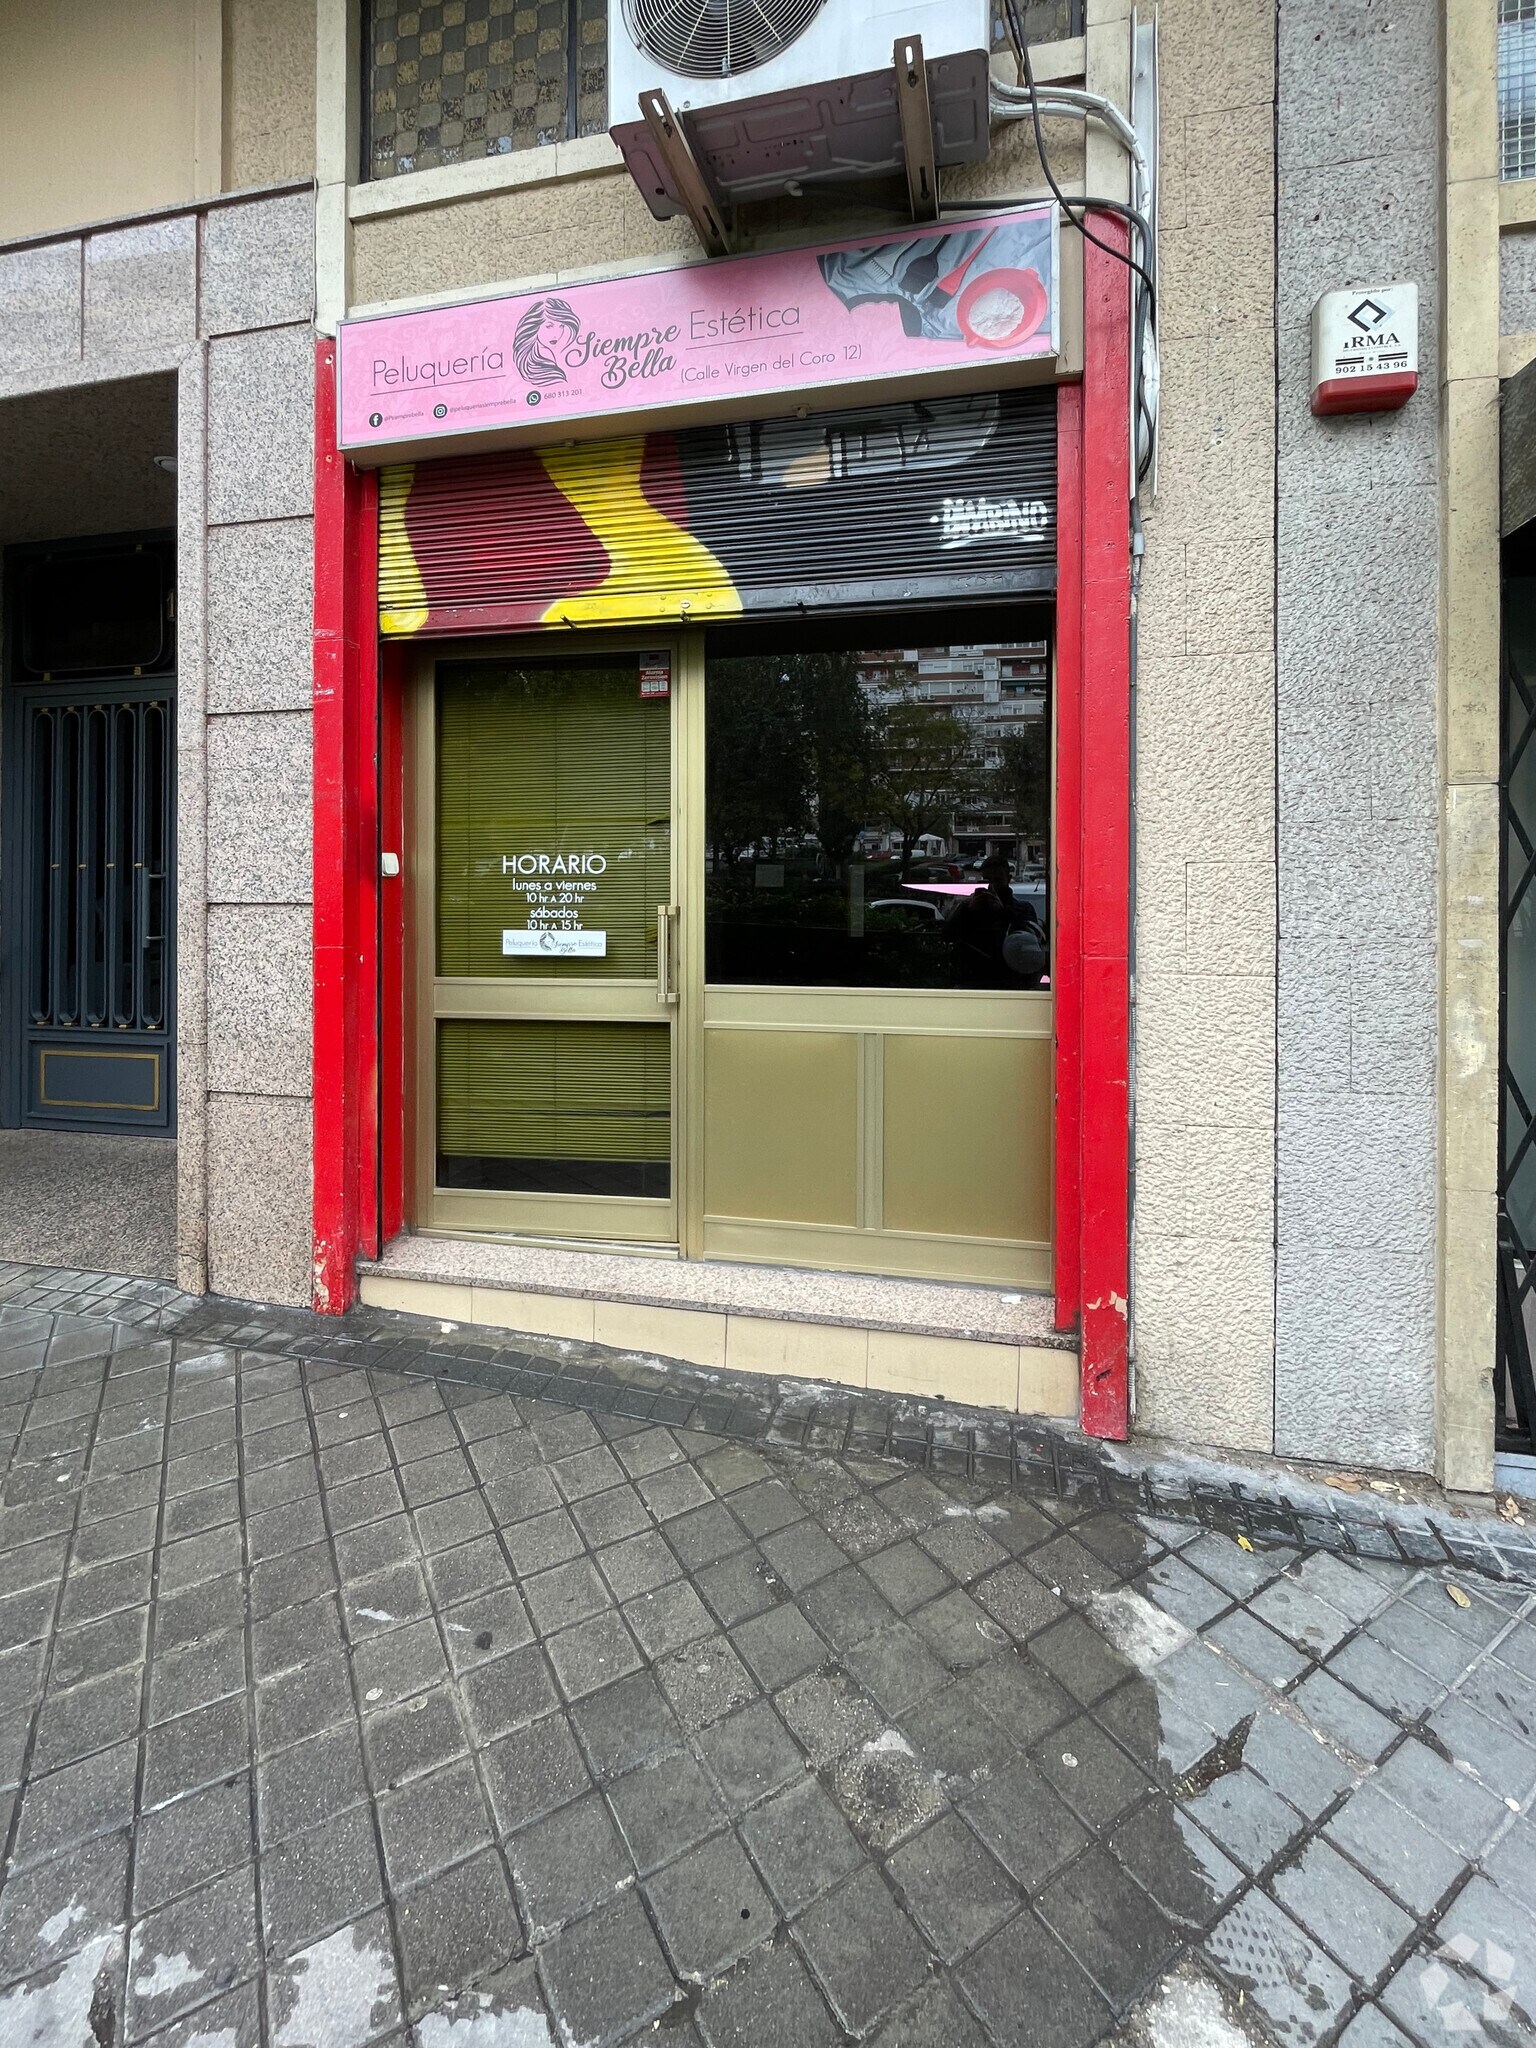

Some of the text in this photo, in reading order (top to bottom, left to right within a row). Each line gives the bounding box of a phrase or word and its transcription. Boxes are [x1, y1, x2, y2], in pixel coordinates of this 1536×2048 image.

[690, 306, 800, 340] Estética
[565, 324, 682, 368] Siempre
[372, 347, 504, 388] Peluquería
[600, 347, 678, 390] Bella
[680, 344, 863, 384] (Calle Virgen del Coro 12)
[1335, 360, 1408, 374] 902 15 43 96
[543, 388, 582, 400] 680 313 201
[502, 854, 607, 875] HORARIO
[512, 877, 597, 891] lunes a viernes
[526, 892, 537, 903] 10
[539, 892, 549, 903] hr
[559, 892, 572, 903] 20
[574, 892, 585, 903] hr
[530, 905, 579, 918] sábados
[527, 920, 538, 930] 10
[539, 919, 549, 930] hr
[561, 920, 572, 930] 15
[574, 920, 584, 930] hr
